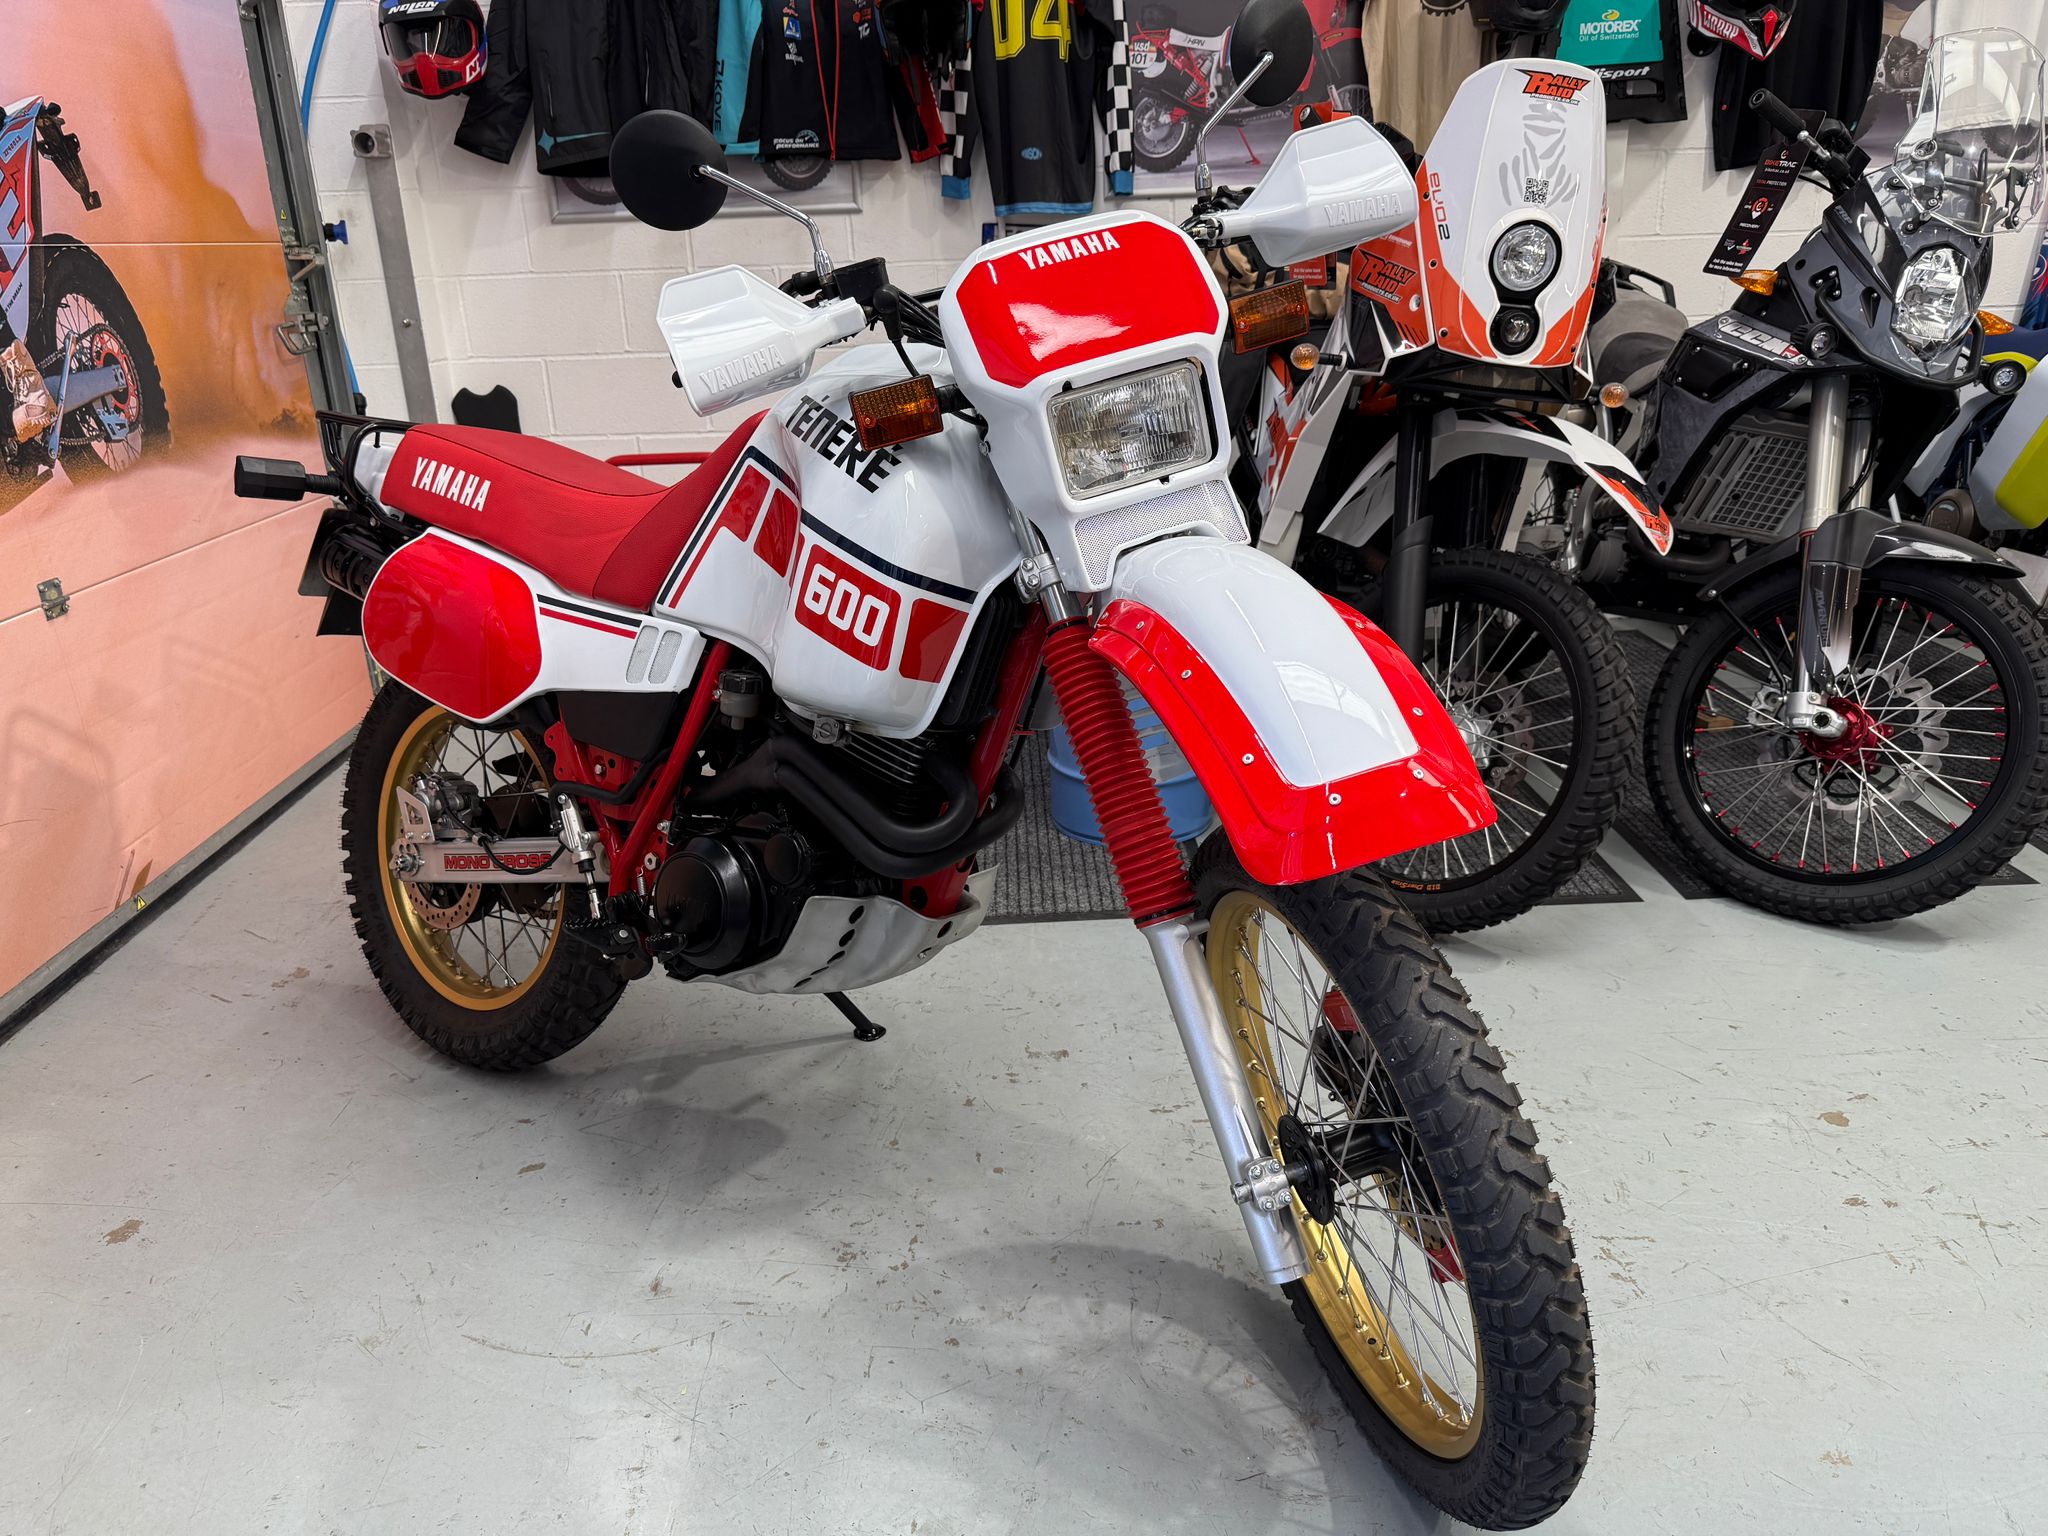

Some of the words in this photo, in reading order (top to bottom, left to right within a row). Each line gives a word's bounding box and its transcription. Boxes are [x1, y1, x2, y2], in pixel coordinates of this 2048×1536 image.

[388, 2, 439, 14] NOLAN
[1579, 20, 1640, 35] MOTOREX
[1590, 34, 1598, 42] of
[1600, 32, 1640, 41] Switzerland
[1131, 53, 1147, 65] 101
[773, 138, 794, 146] FOCUS
[1323, 193, 1402, 228] YAMAHA
[1019, 230, 1121, 270] YAMAHA
[1719, 322, 1791, 356] CCM
[700, 344, 786, 394] YAMAHA
[411, 456, 492, 512] YAMAHA
[804, 563, 890, 647] 600
[1814, 587, 1831, 647] ADVENTURE
[443, 855, 490, 870] MONO
